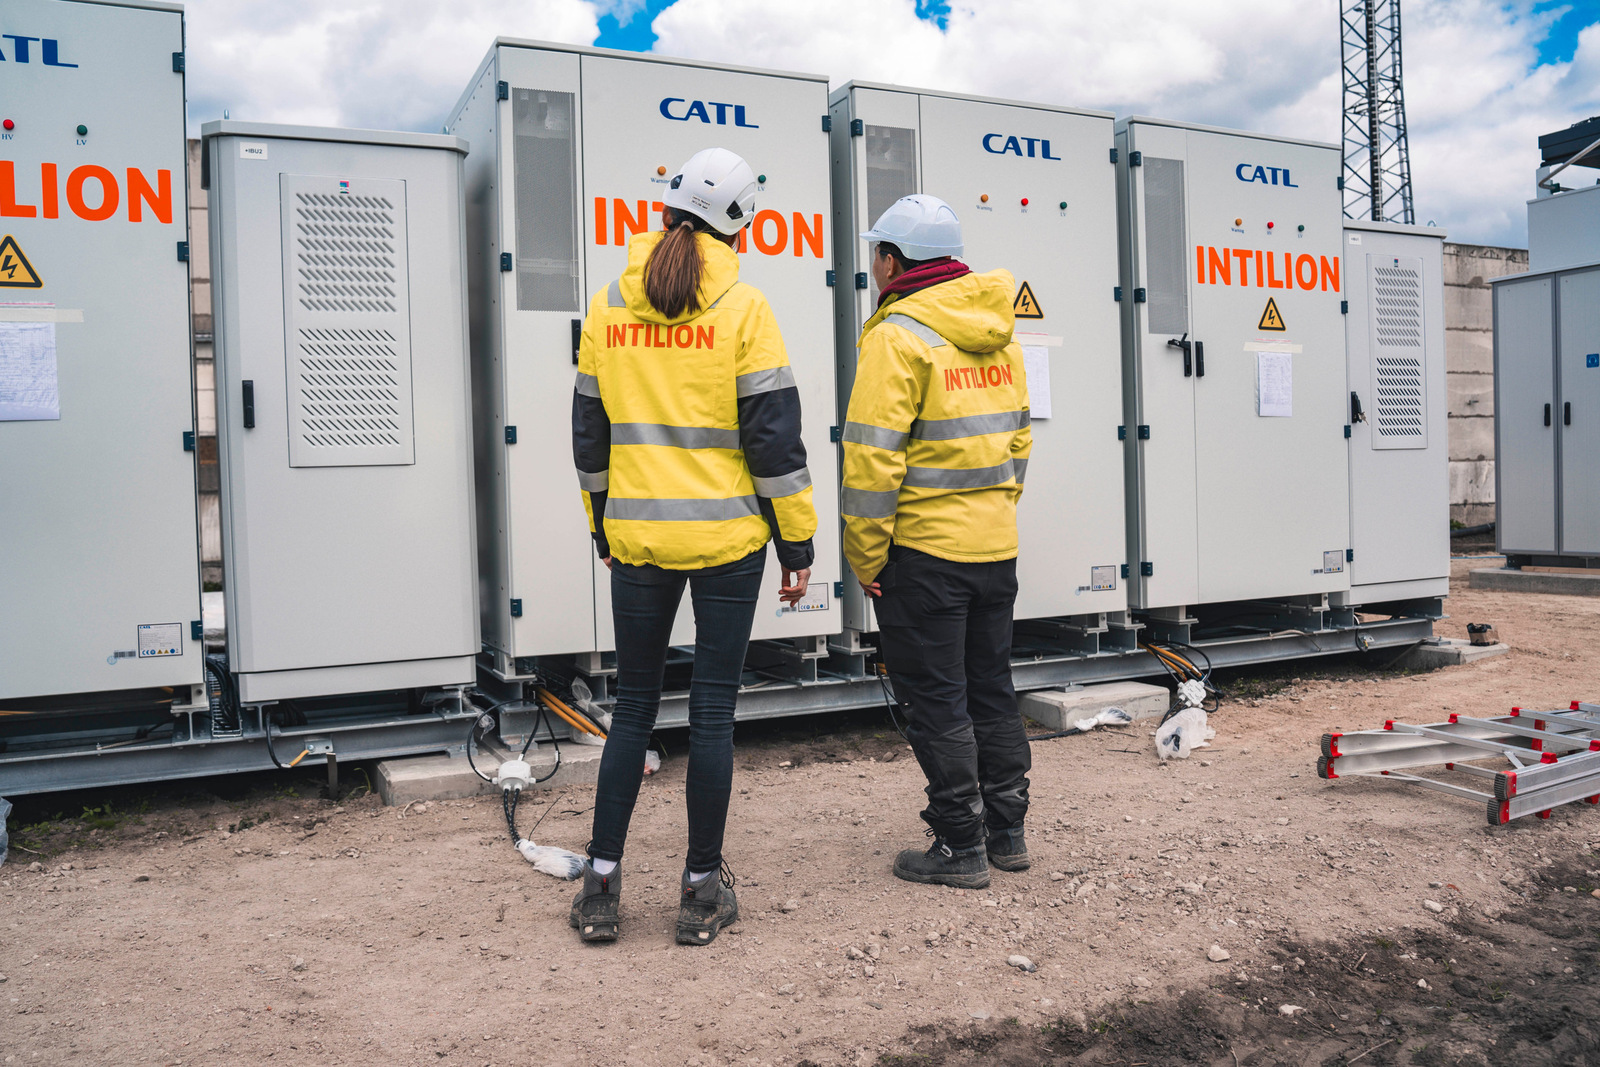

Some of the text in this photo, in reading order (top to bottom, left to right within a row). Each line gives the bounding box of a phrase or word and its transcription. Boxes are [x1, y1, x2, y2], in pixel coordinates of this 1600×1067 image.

[659, 97, 760, 129] CATL
[982, 133, 1062, 161] CATL
[1235, 163, 1299, 188] CATL
[594, 197, 824, 259] INON
[1196, 245, 1340, 293] INTILION
[606, 323, 715, 350] INTILION
[944, 364, 1013, 392] INTILION
